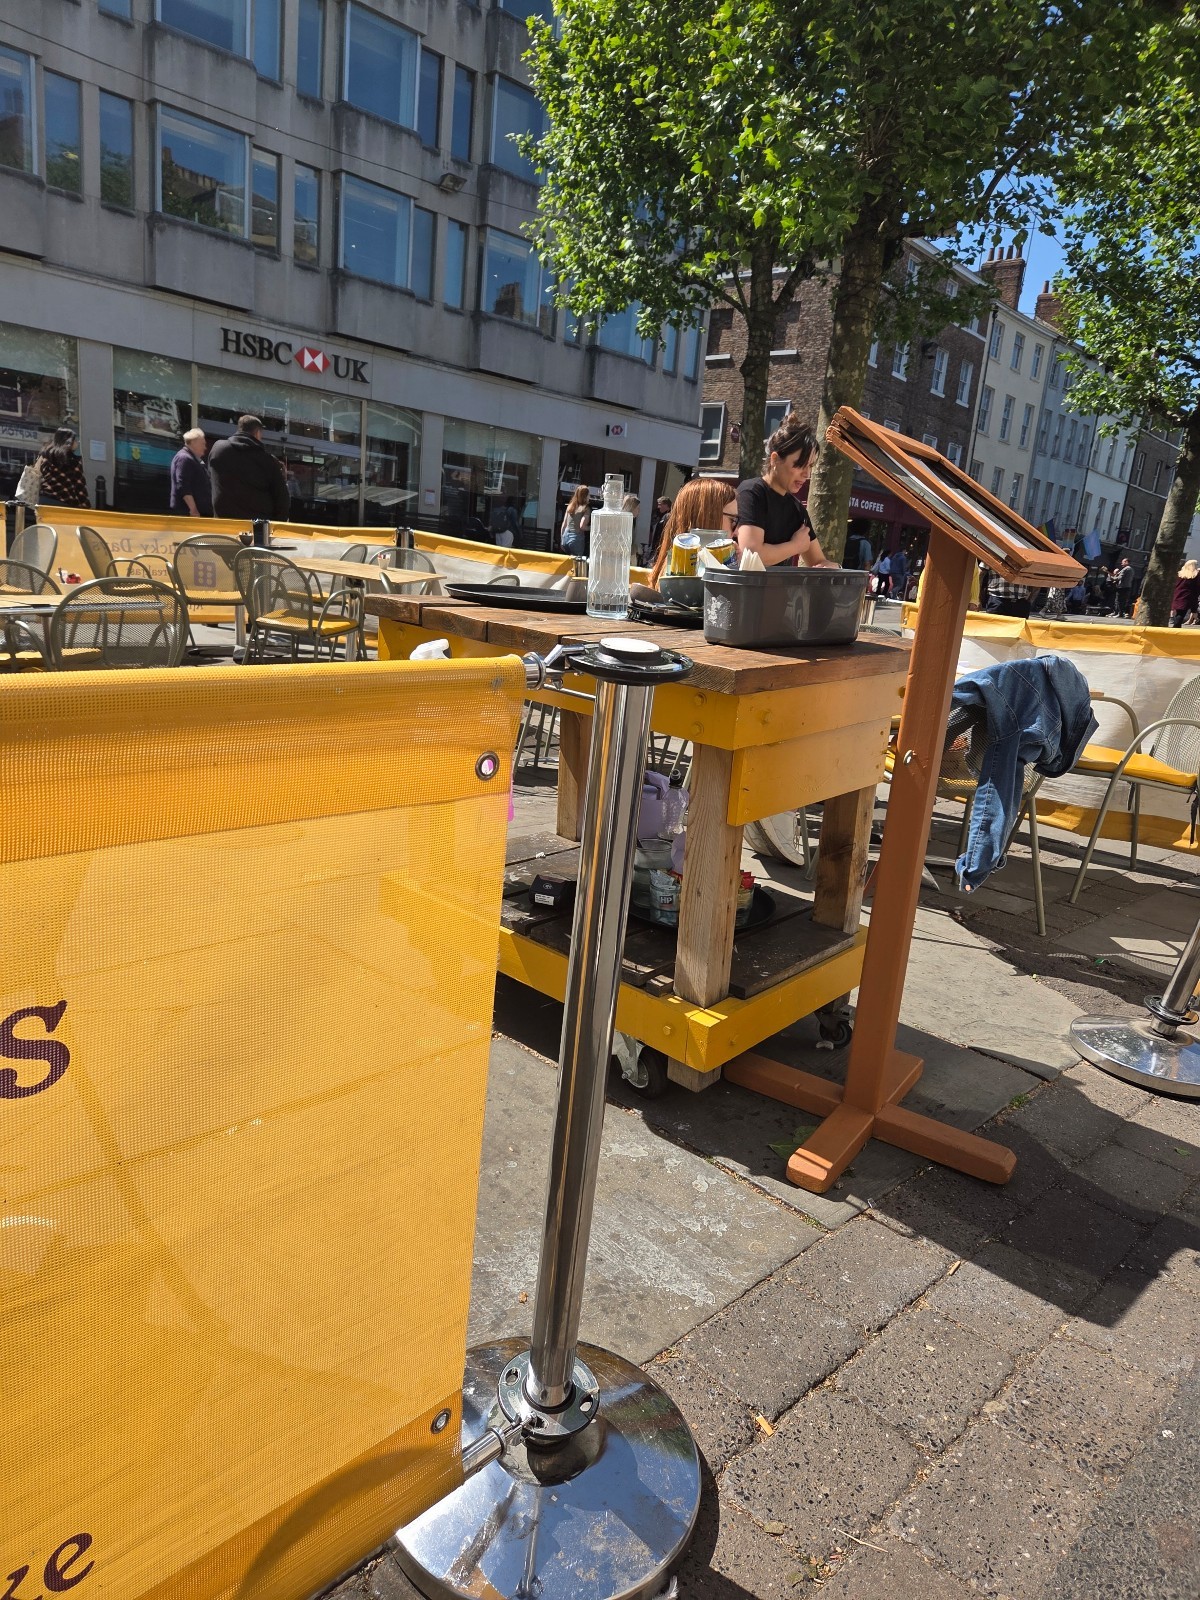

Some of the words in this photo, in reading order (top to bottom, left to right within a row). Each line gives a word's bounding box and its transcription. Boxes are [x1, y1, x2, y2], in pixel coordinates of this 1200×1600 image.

[220, 327, 293, 366] HSBC
[331, 354, 370, 384] UK
[849, 497, 859, 508] TA
[860, 500, 884, 513] COFFEE
[660, 896, 673, 904] HP
